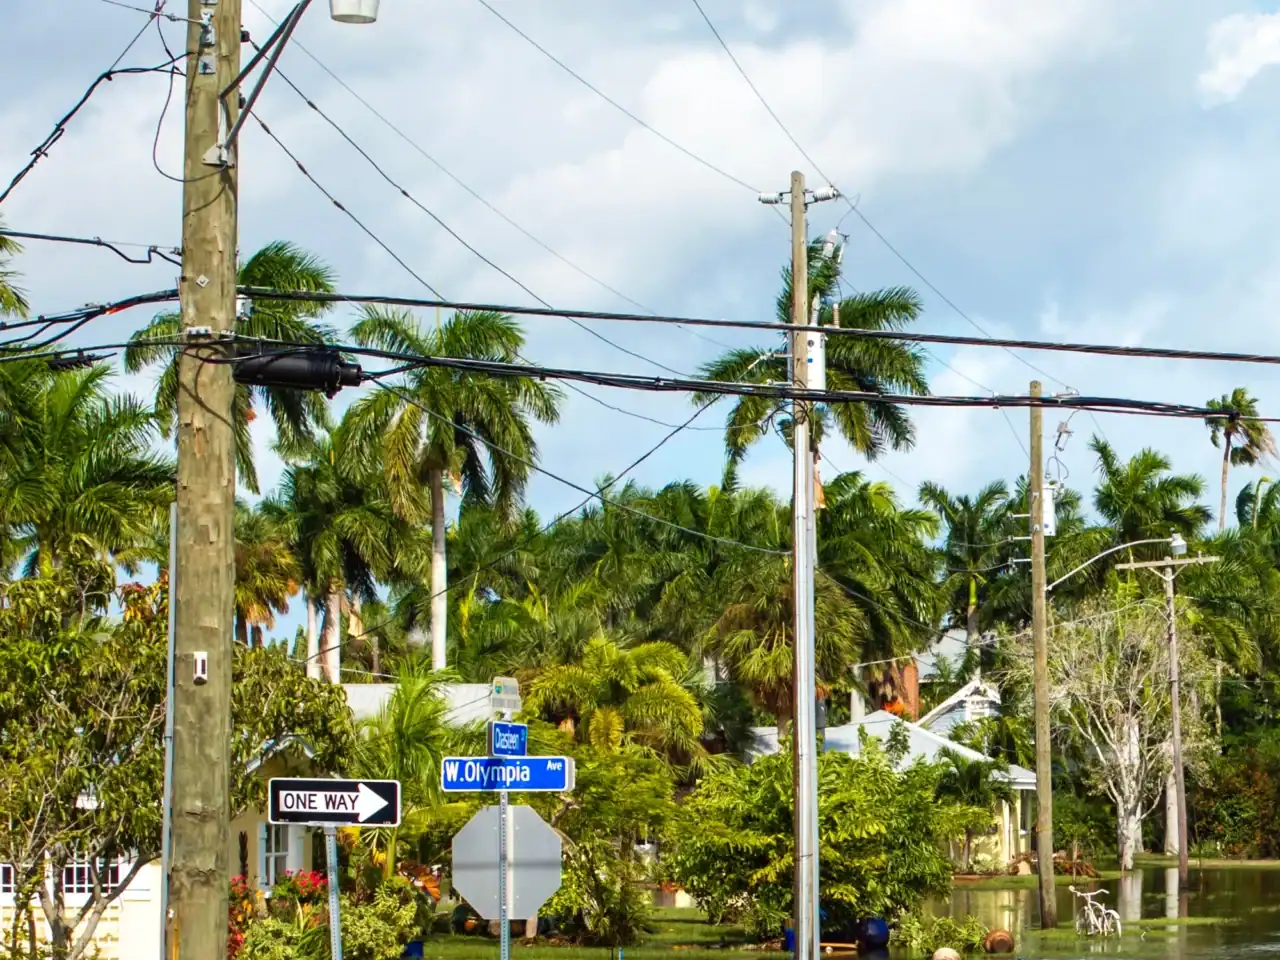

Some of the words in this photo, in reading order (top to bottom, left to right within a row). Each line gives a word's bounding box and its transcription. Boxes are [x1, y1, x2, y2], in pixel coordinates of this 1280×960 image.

[547, 760, 563, 771] Ave
[284, 793, 318, 810] ONE
[324, 794, 360, 811] WAY
